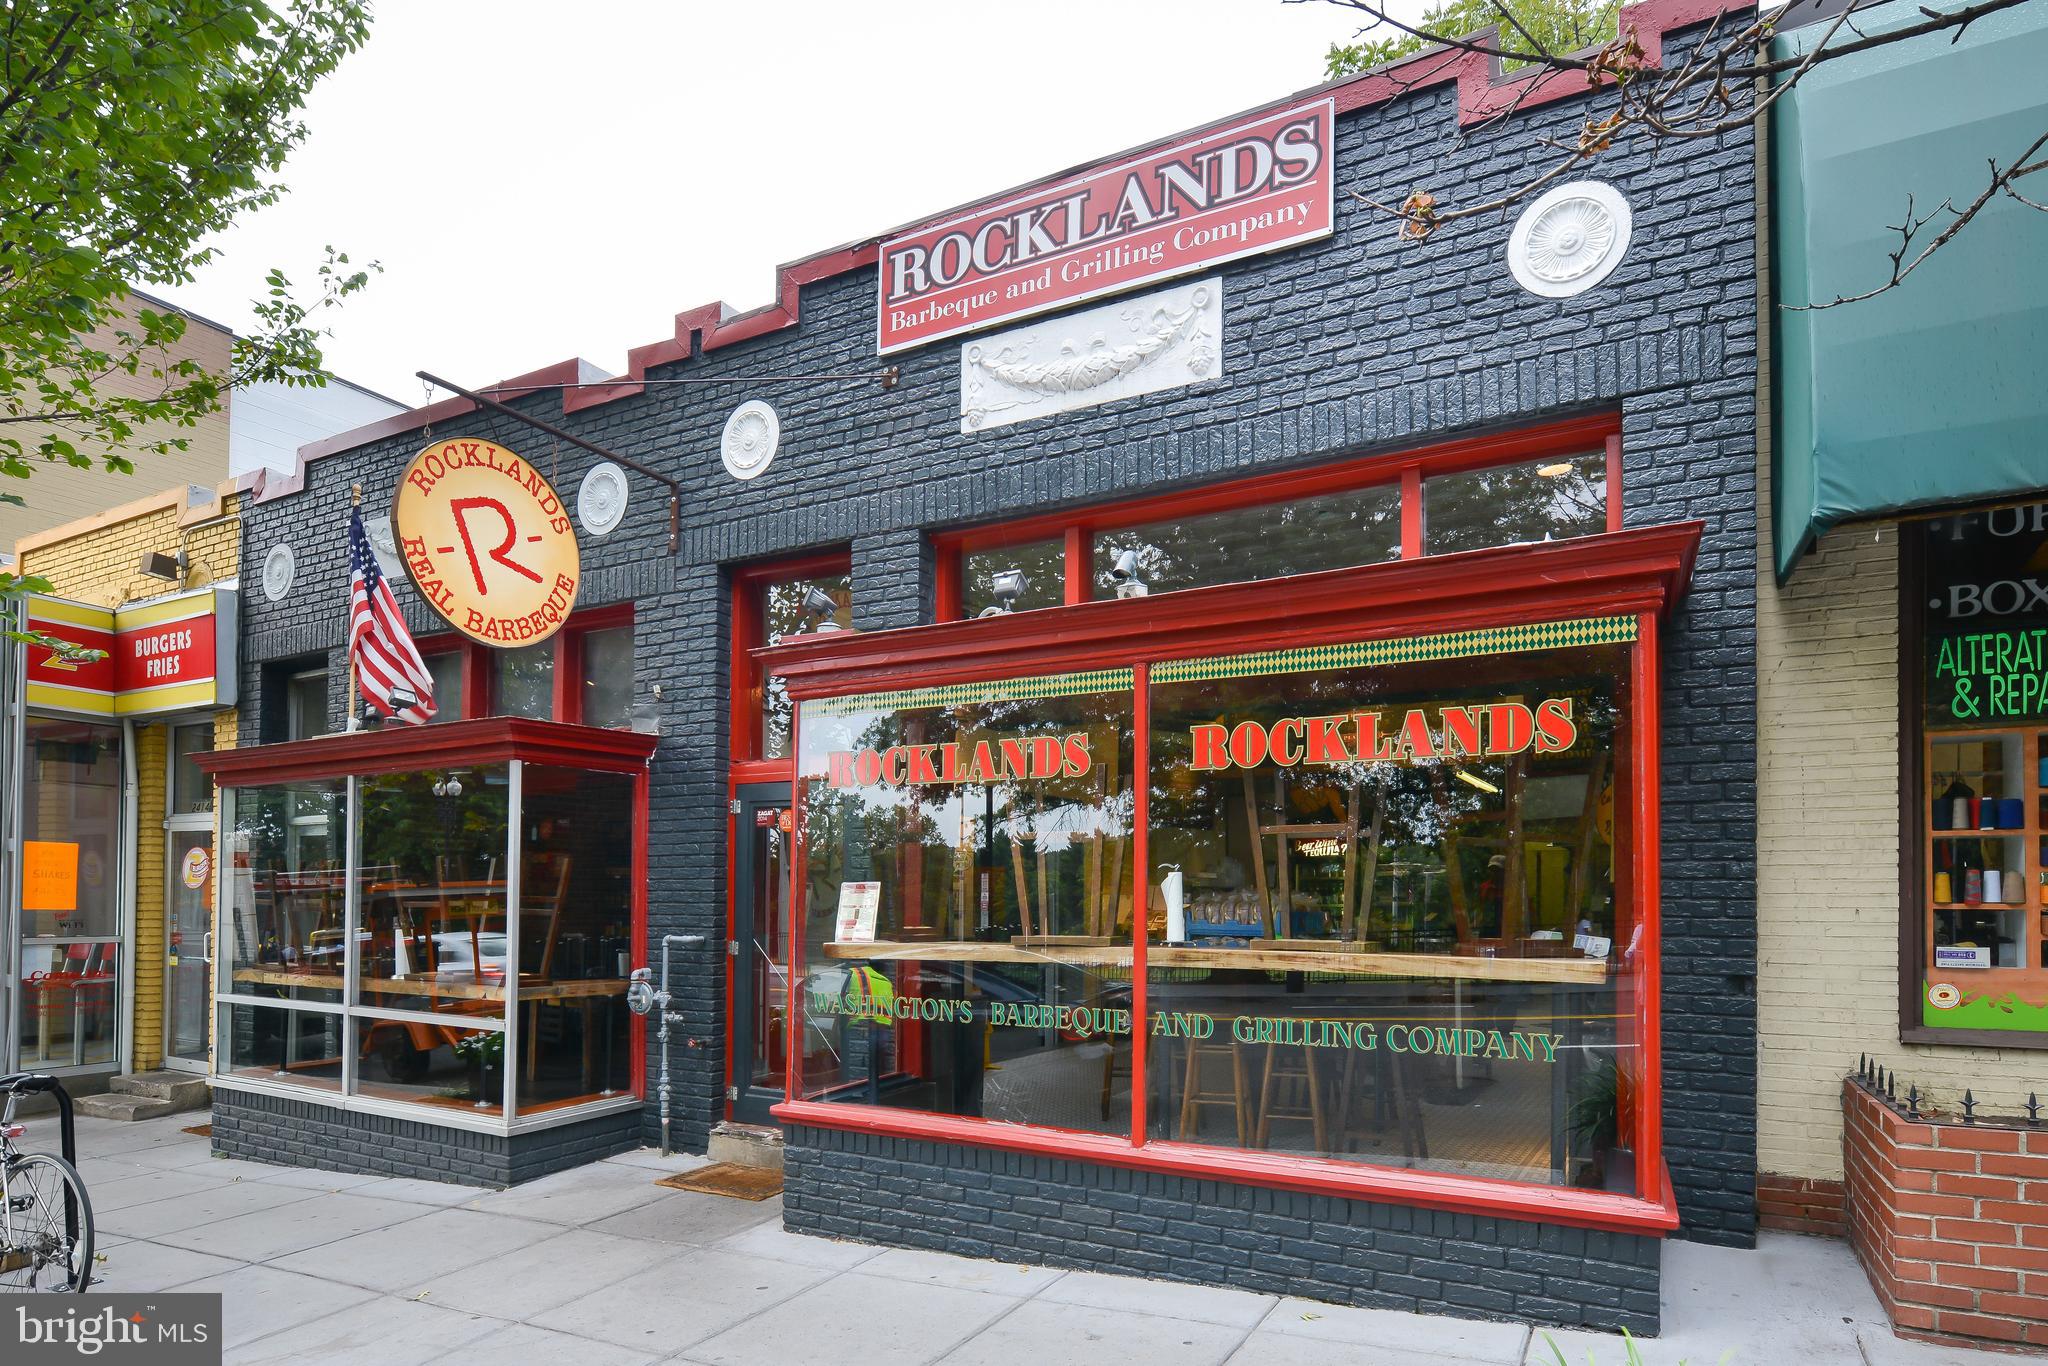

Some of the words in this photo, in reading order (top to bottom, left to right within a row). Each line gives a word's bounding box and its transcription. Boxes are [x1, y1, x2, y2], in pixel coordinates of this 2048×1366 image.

[884, 114, 1322, 301] ROCKLANDS
[890, 289, 998, 332] Barbeque
[1006, 267, 1051, 299] and
[1061, 242, 1164, 280] Grilling
[1174, 199, 1314, 252] Company
[407, 443, 570, 535] ROCKLANDS
[401, 535, 455, 616] REAL
[464, 573, 575, 641] BARBEQUE
[1948, 579, 2048, 618] BOX
[135, 629, 192, 658] BURGERS
[146, 655, 180, 678] FRIES
[1936, 630, 2047, 678] ALTERAT
[1951, 678, 1980, 718] &
[827, 733, 1091, 788] ROCKLANDS
[1189, 698, 1577, 770] ROCKLANDS
[813, 992, 973, 1024] WASHINGTON'S
[990, 1002, 1132, 1038] BARBEQUE
[1152, 1011, 1214, 1038] AND
[1233, 1016, 1378, 1050] GRILLING
[1386, 1024, 1564, 1063] COMPANY
